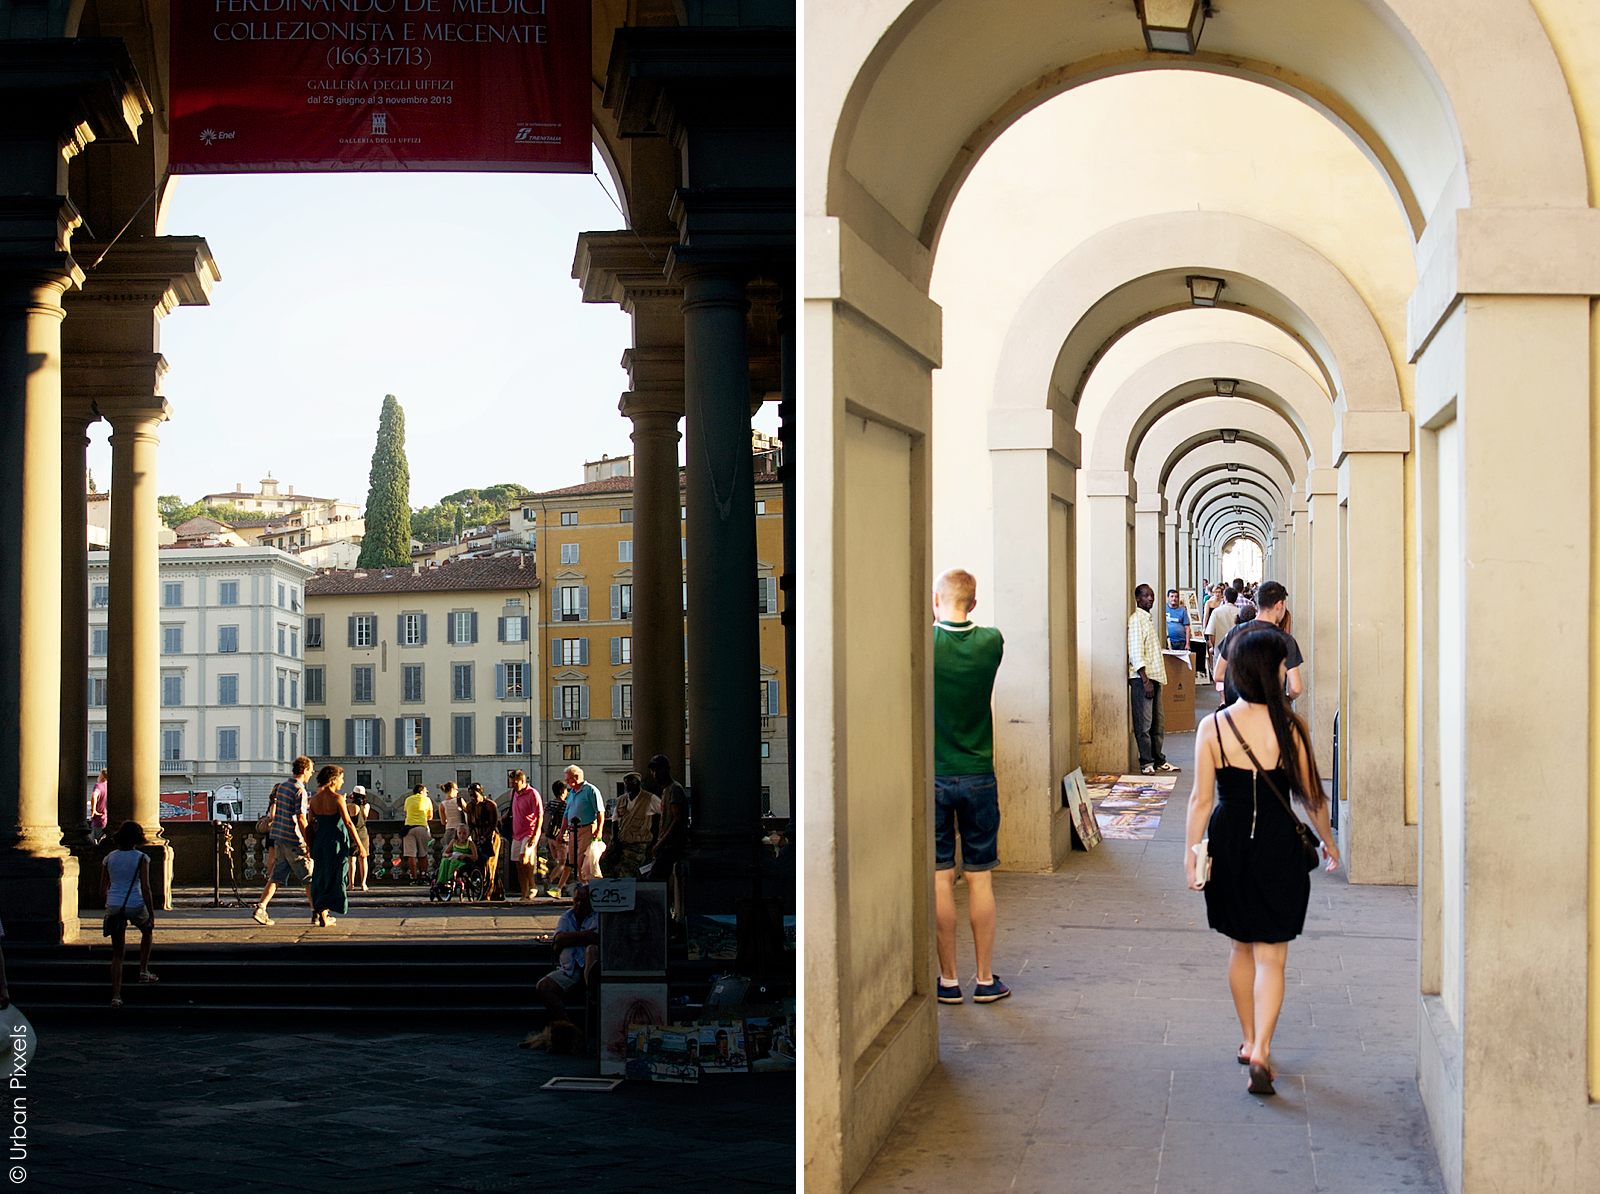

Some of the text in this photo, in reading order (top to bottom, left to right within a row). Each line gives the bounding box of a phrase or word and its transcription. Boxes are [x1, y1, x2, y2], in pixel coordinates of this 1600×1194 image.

[213, 21, 548, 44] COLLEZIONISTA E MECENATE
[326, 46, 432, 70] (1663-1713)
[307, 79, 454, 90] GALLERIA DEGLI UFFIZI
[307, 95, 453, 106] dal 25 giugno al 3 novembre 2013
[218, 130, 236, 140] Enel
